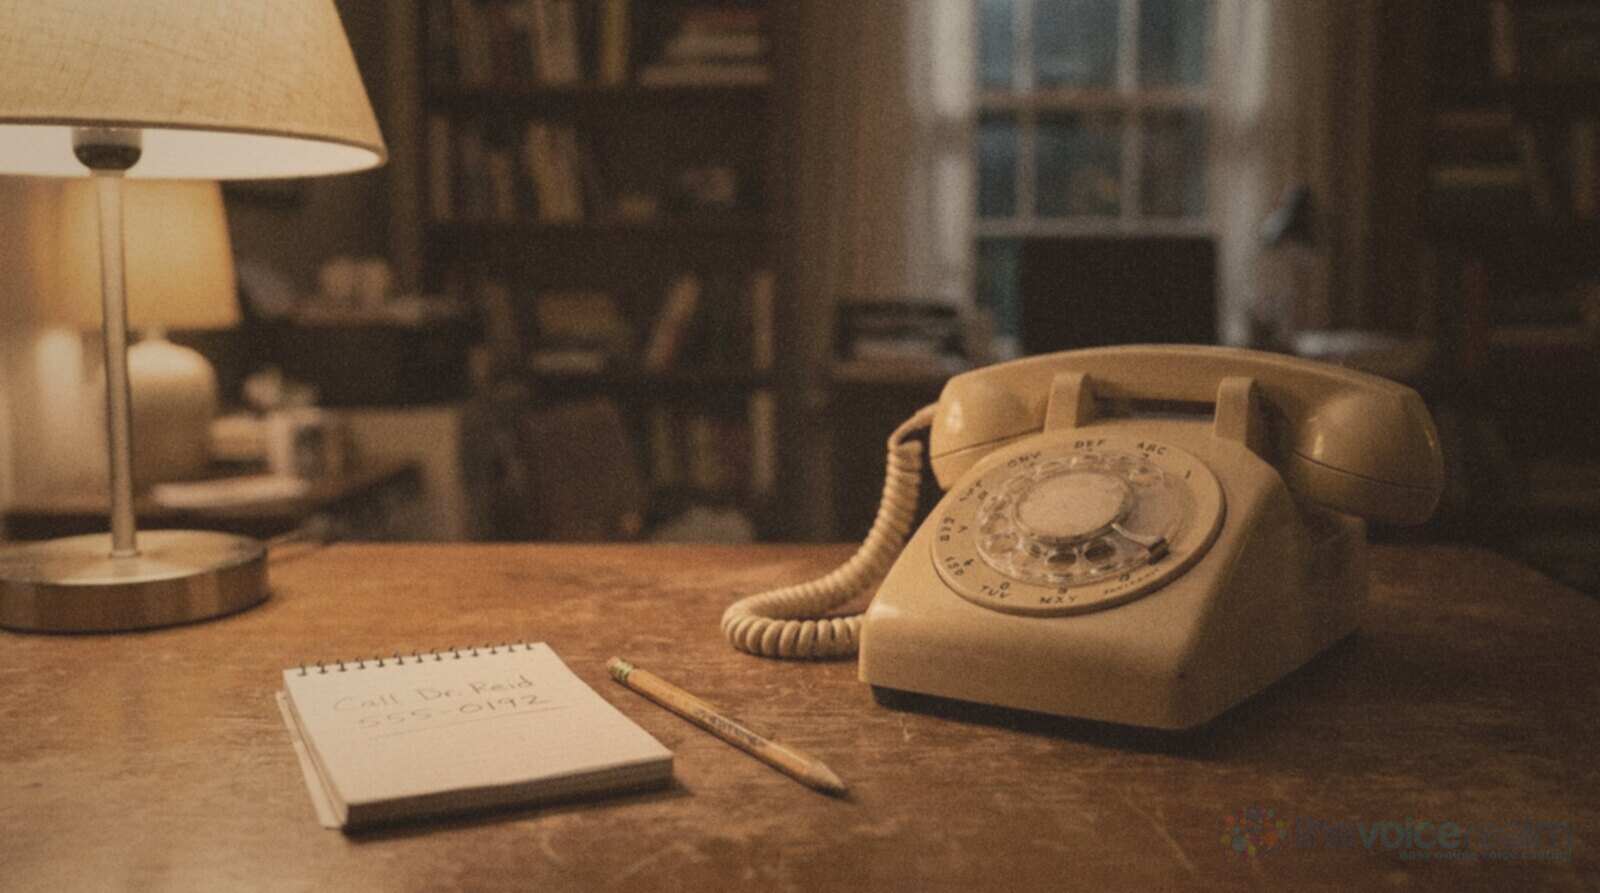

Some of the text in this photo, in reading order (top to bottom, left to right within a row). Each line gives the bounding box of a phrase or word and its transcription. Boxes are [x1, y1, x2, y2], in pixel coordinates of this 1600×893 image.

[333, 674, 535, 712] Call Dr. Reid
[358, 694, 551, 729] 555-0192
